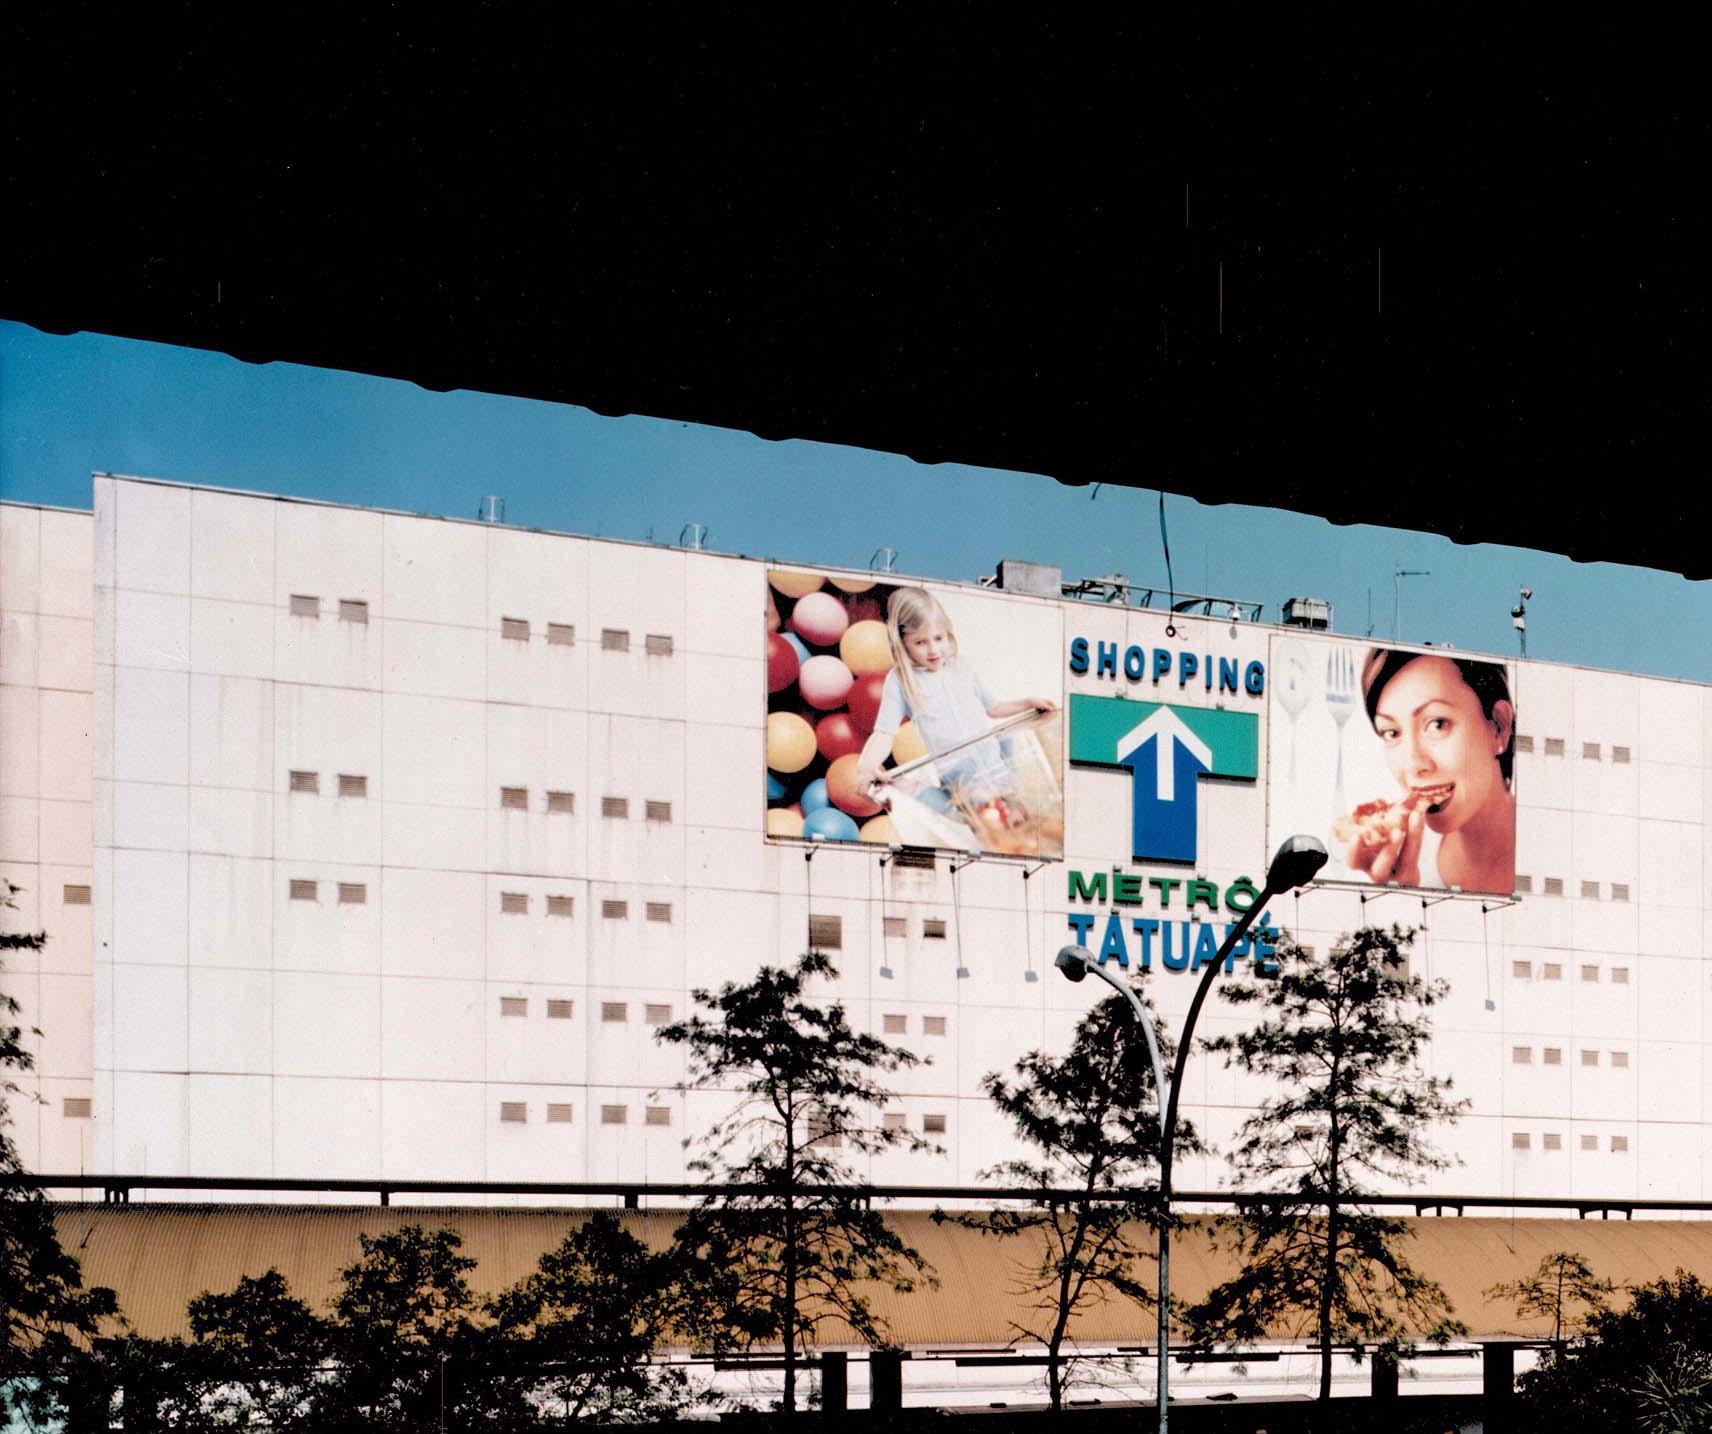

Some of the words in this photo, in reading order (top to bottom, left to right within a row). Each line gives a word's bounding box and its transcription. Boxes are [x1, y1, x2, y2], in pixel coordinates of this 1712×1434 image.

[1070, 637, 1265, 696] SHOPPING
[1068, 870, 1262, 914] METRÔ
[1068, 911, 1280, 978] TATUAPÉ
